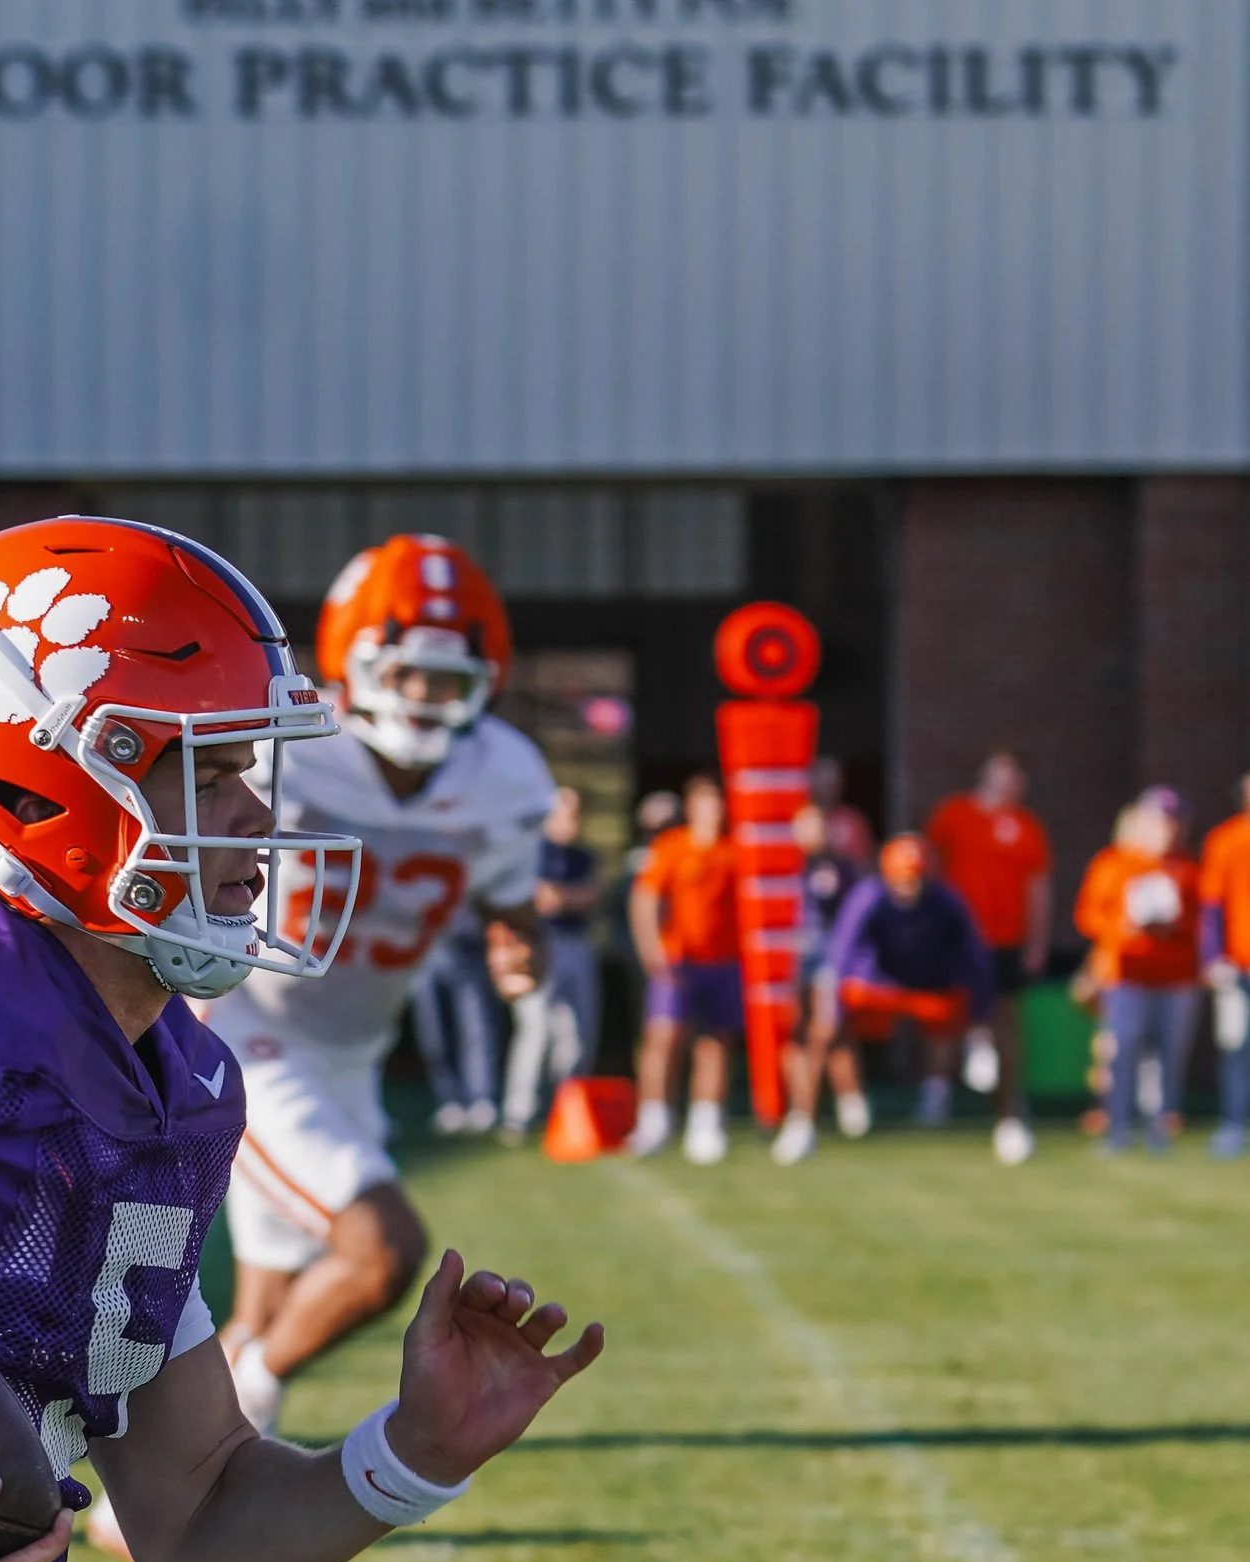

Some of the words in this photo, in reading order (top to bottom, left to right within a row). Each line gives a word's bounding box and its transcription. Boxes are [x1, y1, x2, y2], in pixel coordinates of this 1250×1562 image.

[234, 39, 716, 120] PRACTICE
[745, 40, 1179, 120] FACILITY
[280, 845, 468, 972] 23
